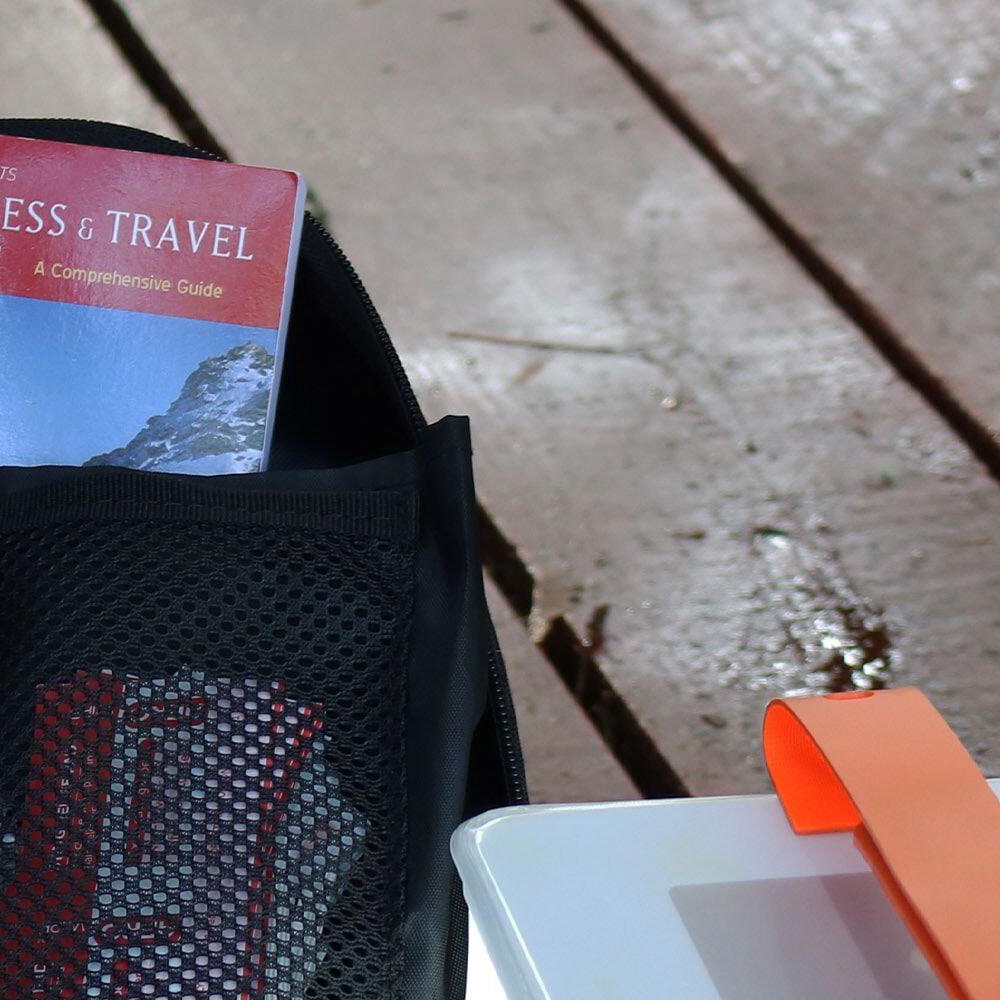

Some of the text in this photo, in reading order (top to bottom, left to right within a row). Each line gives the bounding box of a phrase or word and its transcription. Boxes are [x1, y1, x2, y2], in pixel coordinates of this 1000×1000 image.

[77, 217, 94, 240] &
[106, 210, 254, 261] TRAVEL
[33, 261, 223, 299] A Comprehensive Guide
